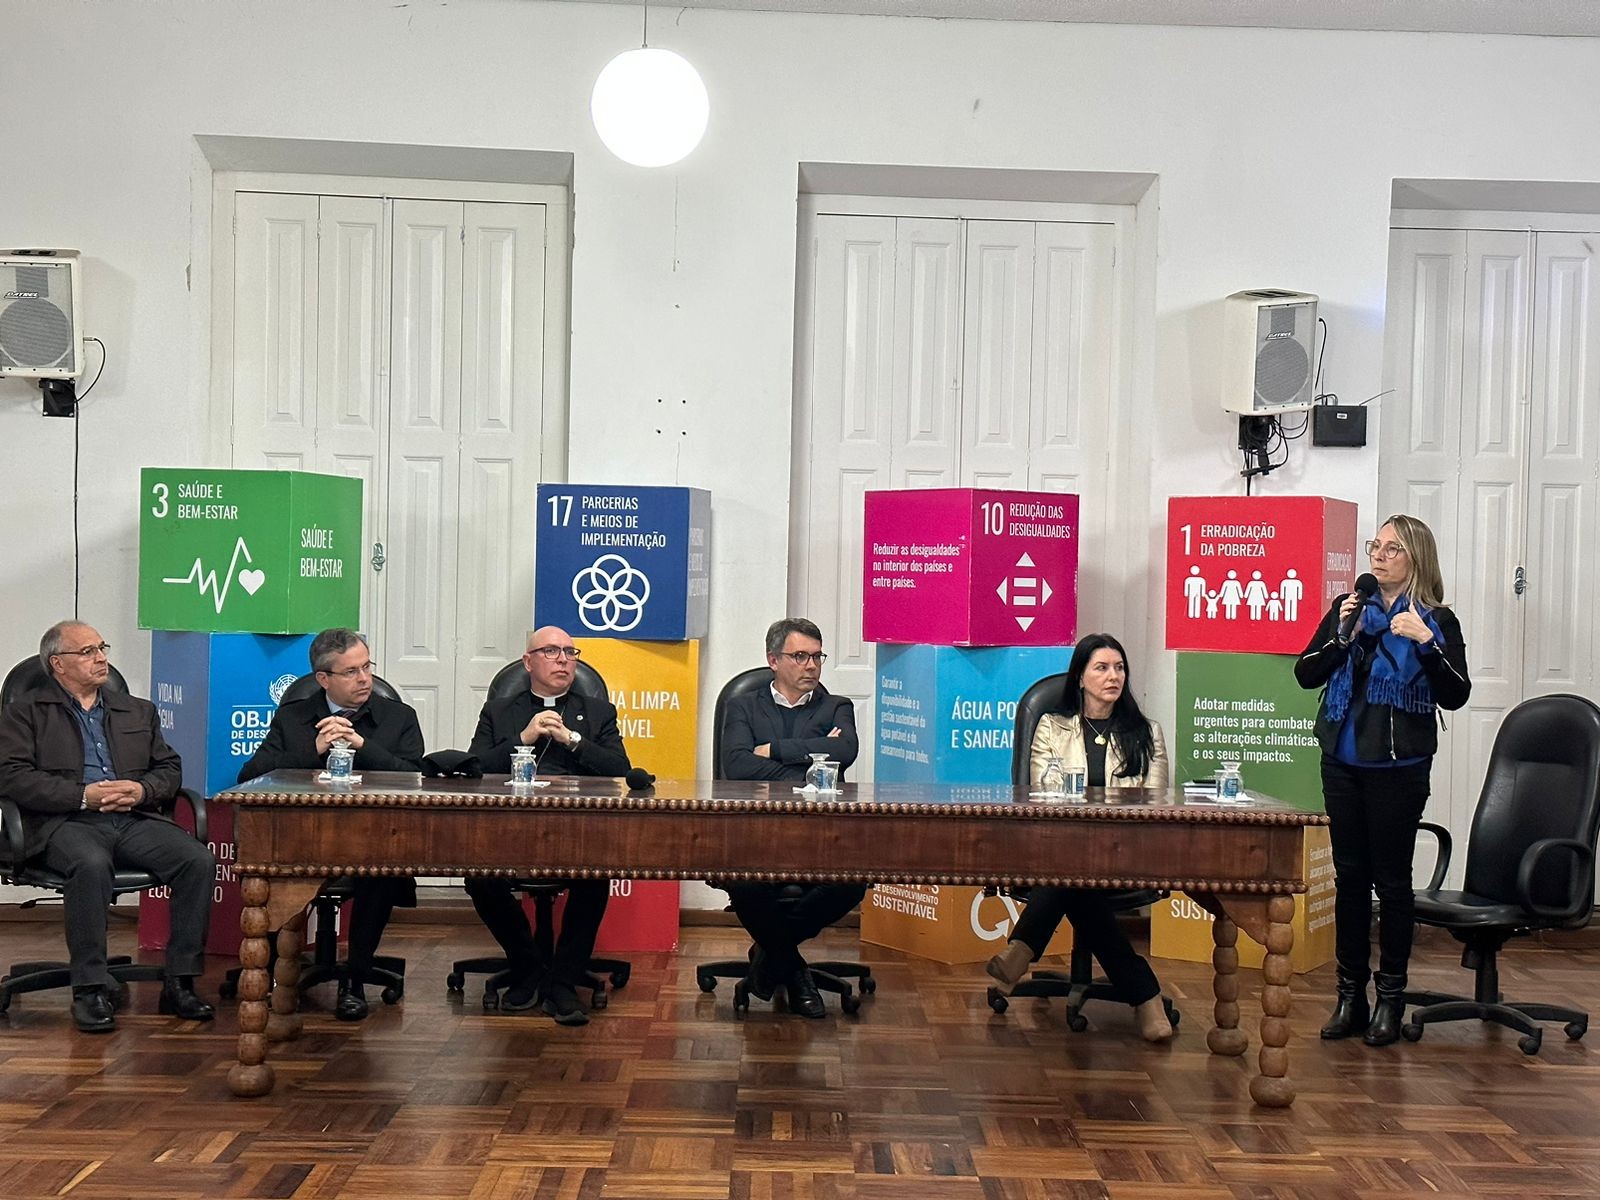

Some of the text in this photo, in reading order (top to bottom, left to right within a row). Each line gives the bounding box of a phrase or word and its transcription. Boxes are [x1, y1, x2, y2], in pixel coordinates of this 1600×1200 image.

[178, 480, 222, 498] SAÚDE E
[152, 482, 168, 518] 3
[582, 496, 638, 510] PARCERIAS
[178, 504, 238, 520] BEM-ESTAR
[548, 496, 573, 526] 17
[981, 502, 1004, 536] 10
[1010, 502, 1064, 522] REDUÇÃO DAS
[582, 515, 638, 528] E MEIOS DE
[1010, 522, 1070, 539] DESIGUALDADES
[302, 524, 333, 548] SAÚDE E
[1180, 524, 1191, 555] 1
[1201, 522, 1275, 540] ERRADICAÇÃO
[582, 531, 666, 550] IMPLEMENTAÇÃO
[874, 543, 960, 558] Reduzir as desigualdades
[1200, 544, 1265, 556] DA POBREZA
[301, 558, 342, 578] BEM-ESTAR
[873, 560, 952, 574] no interior dos países e
[873, 576, 916, 590] entre países.
[158, 682, 182, 704] VIDA NA
[632, 690, 680, 710] LIMPA
[952, 696, 1018, 720] ÁGUA PO
[1194, 697, 1275, 712] Adotar medidas
[232, 710, 275, 728] OBJ
[1194, 716, 1238, 728] urgentes
[1242, 718, 1266, 730] para
[232, 730, 244, 739] DE
[952, 730, 959, 748] E
[1194, 731, 1319, 747] as alterações climáticas
[1193, 749, 1294, 764] e os seus impactos.
[882, 884, 938, 905] DESENVOLVIMENTO
[872, 894, 938, 921] SUSTENTÁVEL
